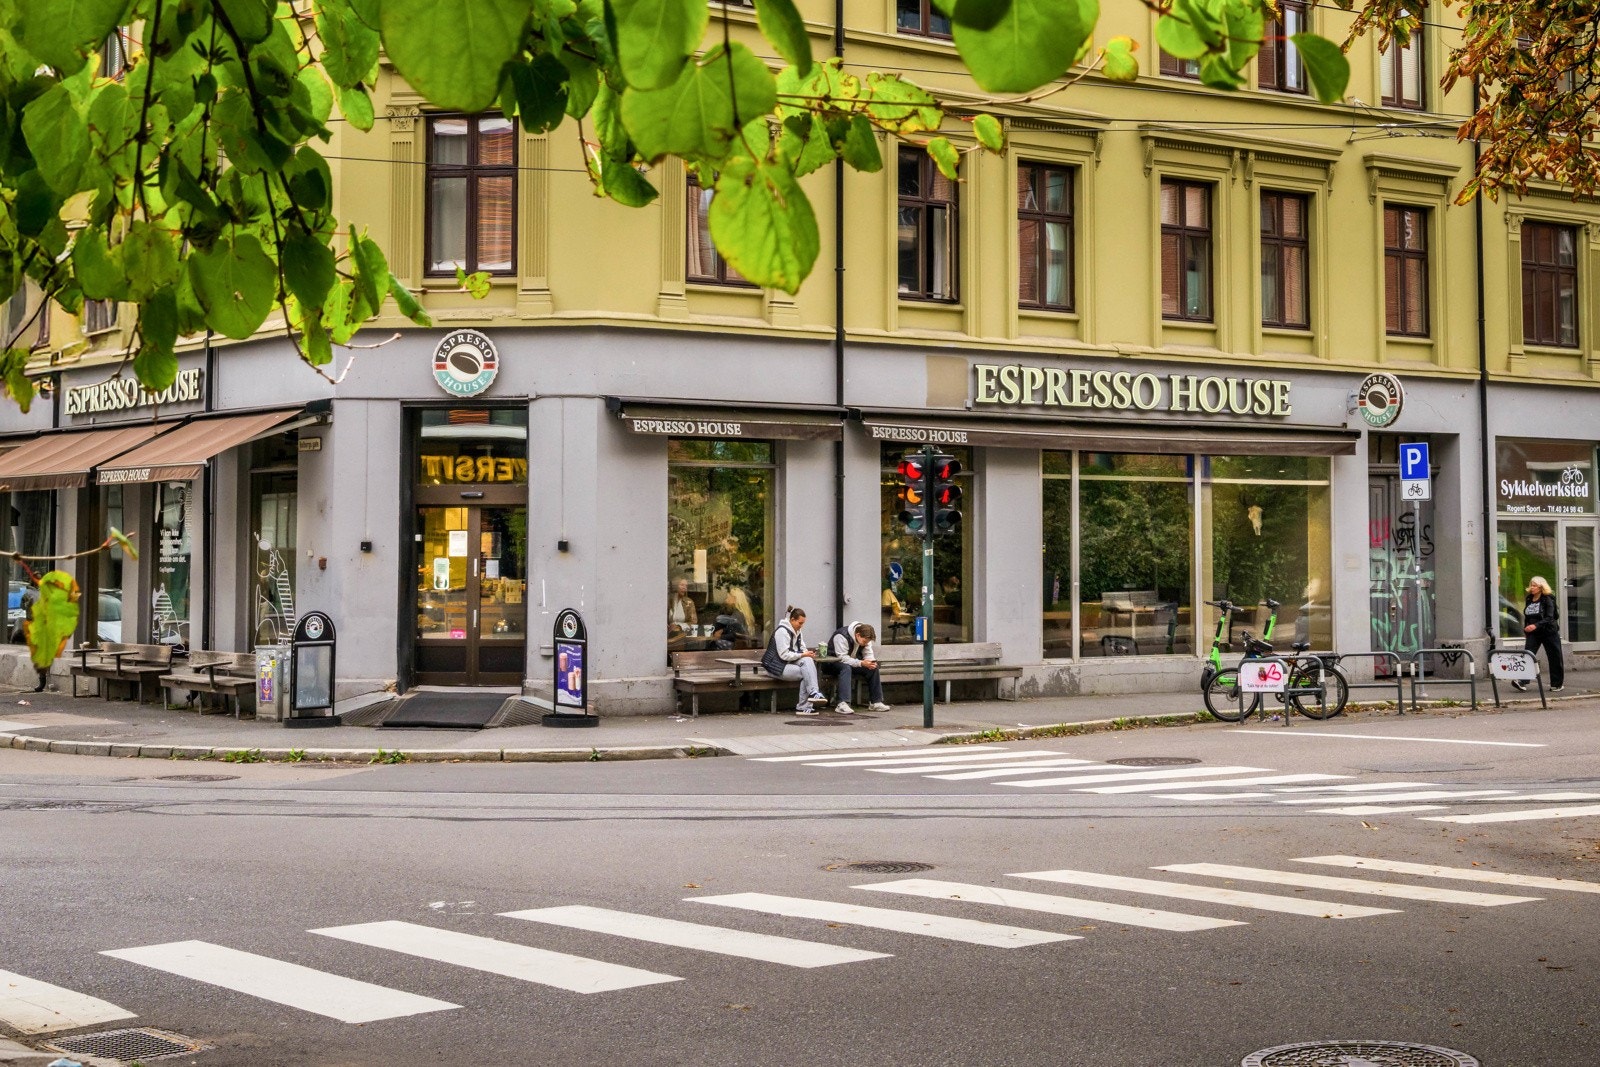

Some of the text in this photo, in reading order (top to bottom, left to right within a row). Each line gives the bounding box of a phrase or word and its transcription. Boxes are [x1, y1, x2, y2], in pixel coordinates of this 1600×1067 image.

[438, 334, 492, 358] ESPRESSO
[444, 377, 486, 392] HOUSE
[975, 364, 1292, 416] ESPRESSO HOUSE
[1361, 376, 1395, 396] ESPRESSO
[64, 378, 138, 415] ESPRESSO
[1364, 411, 1391, 423] HOUSE
[633, 420, 742, 435] ESPRESSO HOUSE
[872, 426, 968, 443] ESPRESSO HOUSE
[1406, 448, 1421, 475] P
[100, 468, 151, 483] ESPRESSO HOUSE
[1501, 480, 1589, 499] Sykkelverksted
[1506, 505, 1525, 513] Regent
[1526, 505, 1541, 513] Sport
